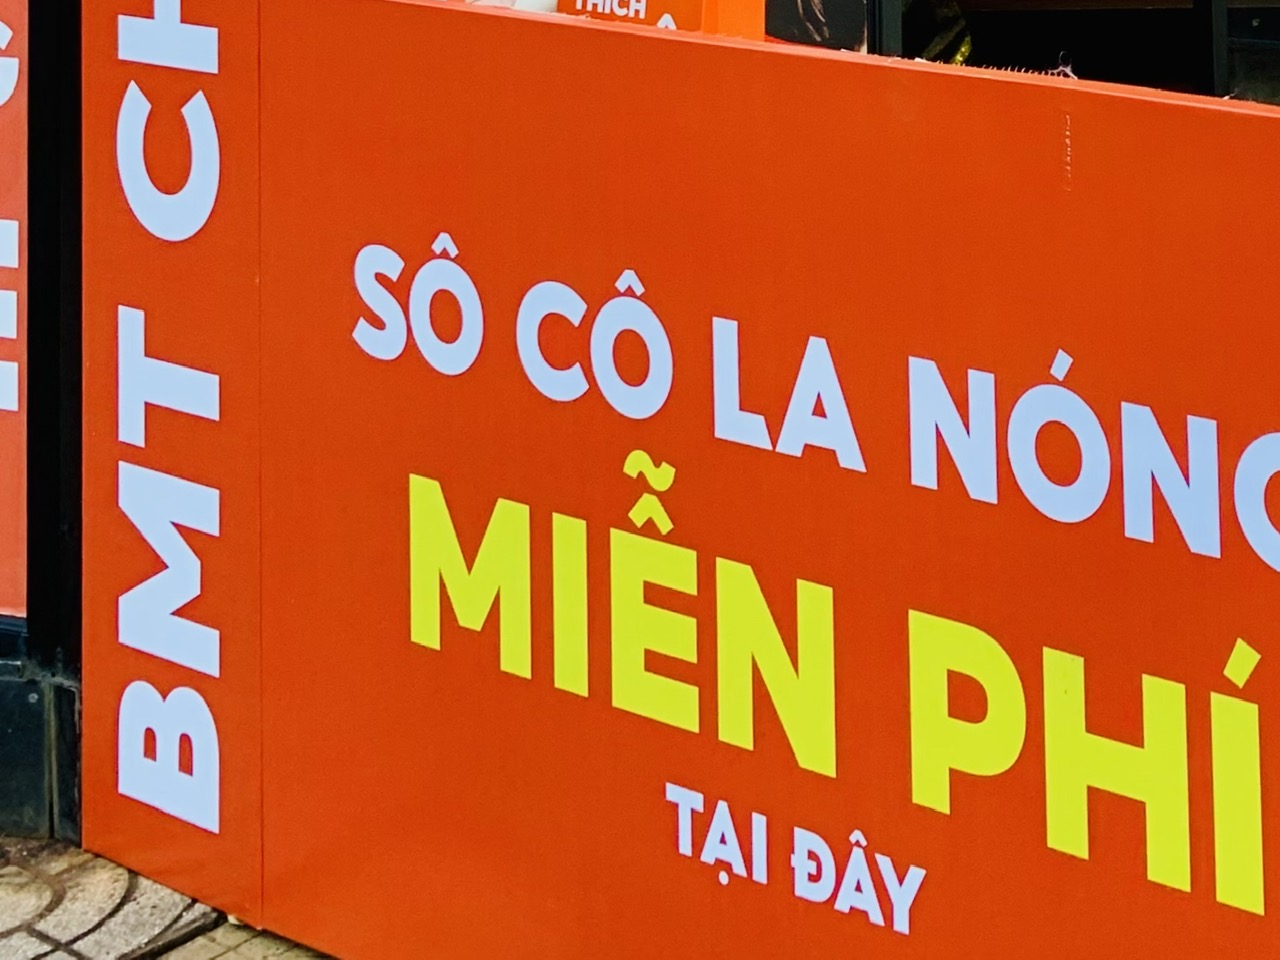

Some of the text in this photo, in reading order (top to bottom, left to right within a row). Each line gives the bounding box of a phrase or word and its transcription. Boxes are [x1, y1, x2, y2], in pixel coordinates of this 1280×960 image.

[351, 231, 484, 376] SÔ
[515, 269, 674, 420] CÔ
[711, 316, 867, 473] LA
[117, 304, 221, 834] BMT
[408, 449, 1266, 917] MIỄN PHÍ
[664, 781, 927, 936] TẠI ĐÂY
